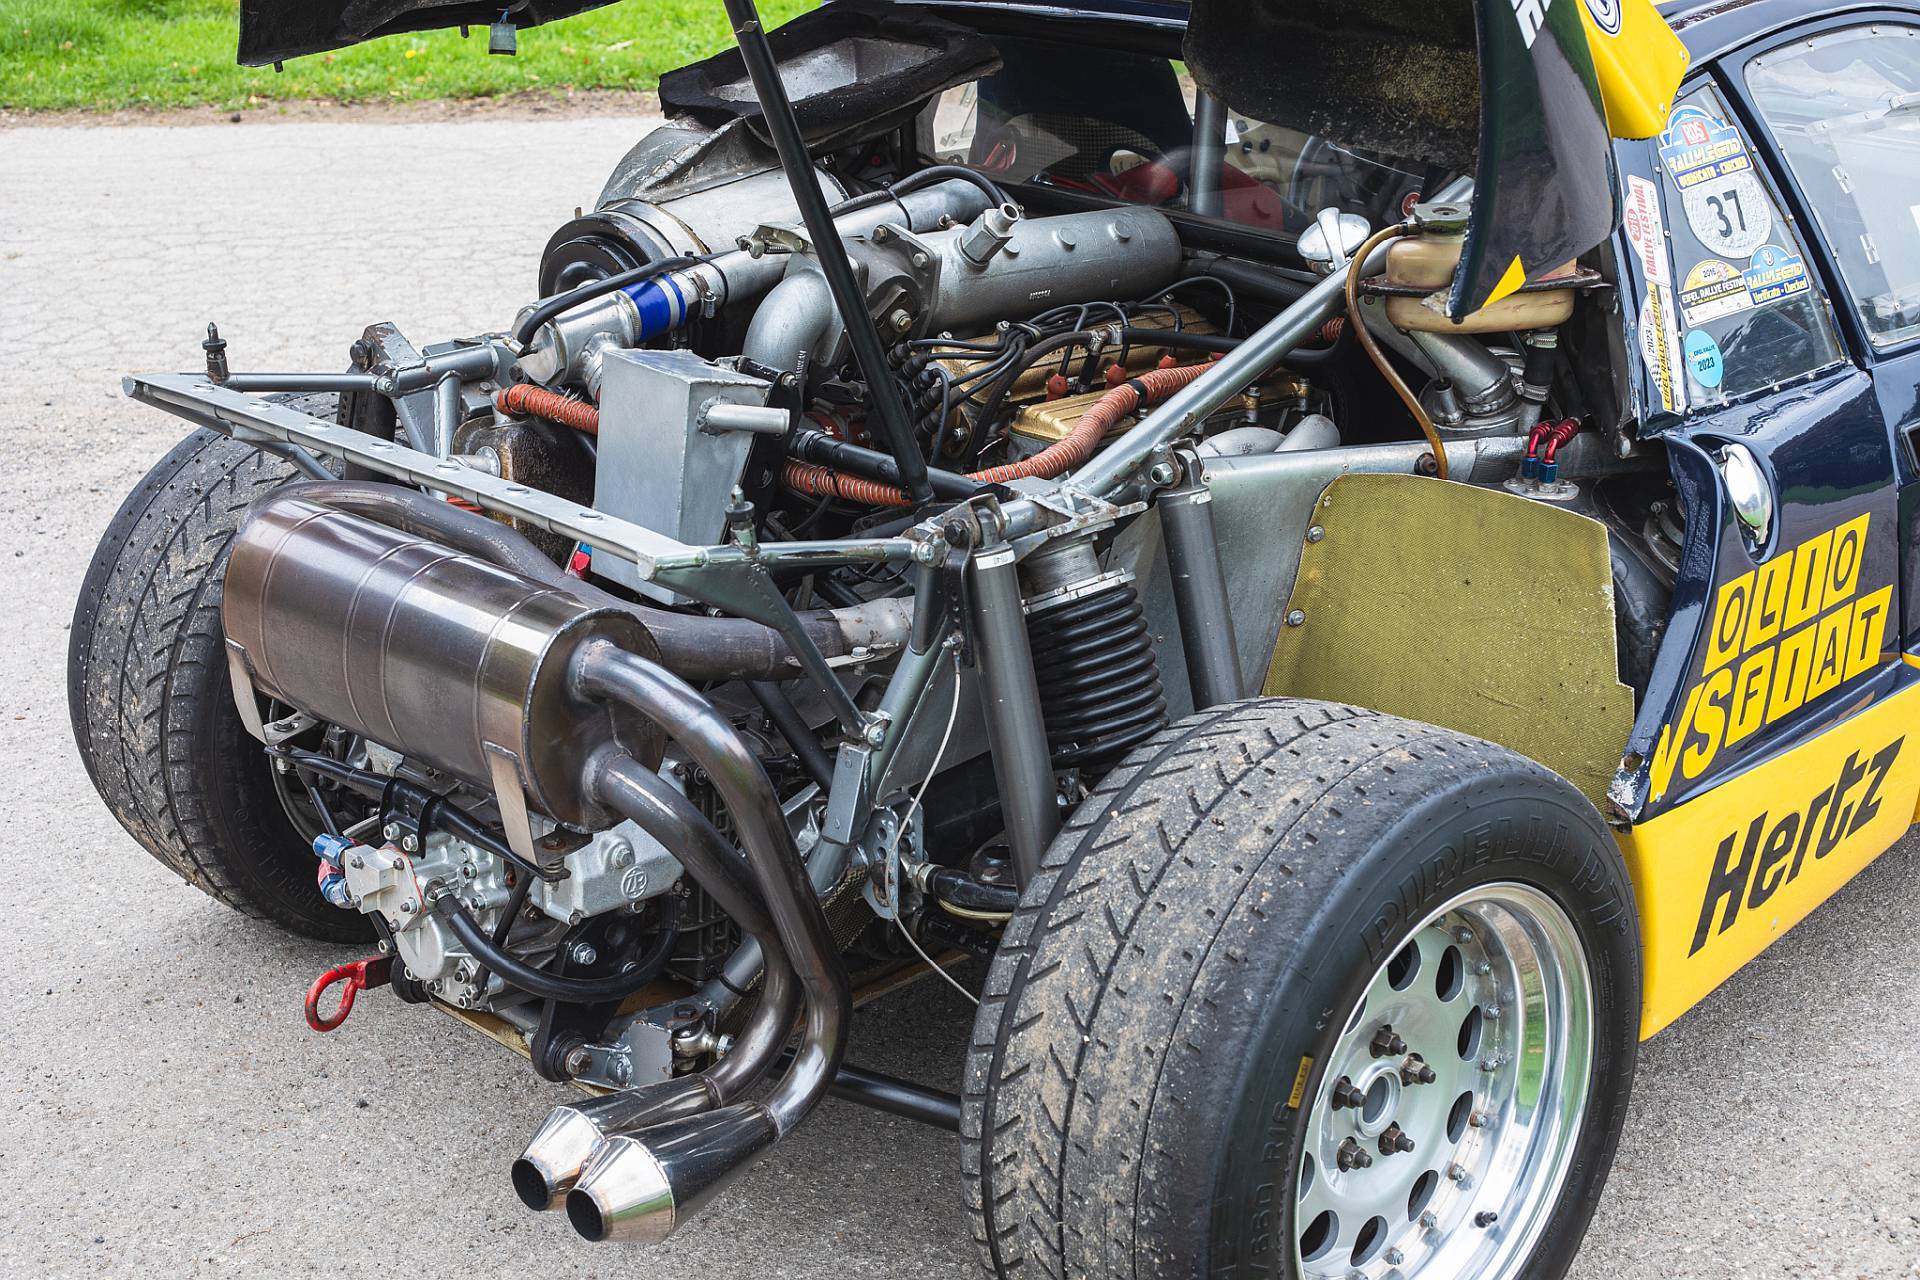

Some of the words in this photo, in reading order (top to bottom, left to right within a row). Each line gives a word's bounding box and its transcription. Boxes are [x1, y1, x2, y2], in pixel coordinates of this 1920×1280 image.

[1633, 183, 1651, 235] FESTIVAL
[1706, 189, 1747, 237] 37
[1644, 237, 1657, 276] RALLYE
[1700, 284, 1722, 299] RALLYE
[1646, 330, 1655, 353] 2023
[1656, 338, 1668, 374] RALLYE
[1697, 356, 1715, 371] 2023
[1661, 375, 1671, 404] EIFEL
[1688, 735, 1905, 959] Hertz
[1360, 815, 1569, 963] PIRELLI
